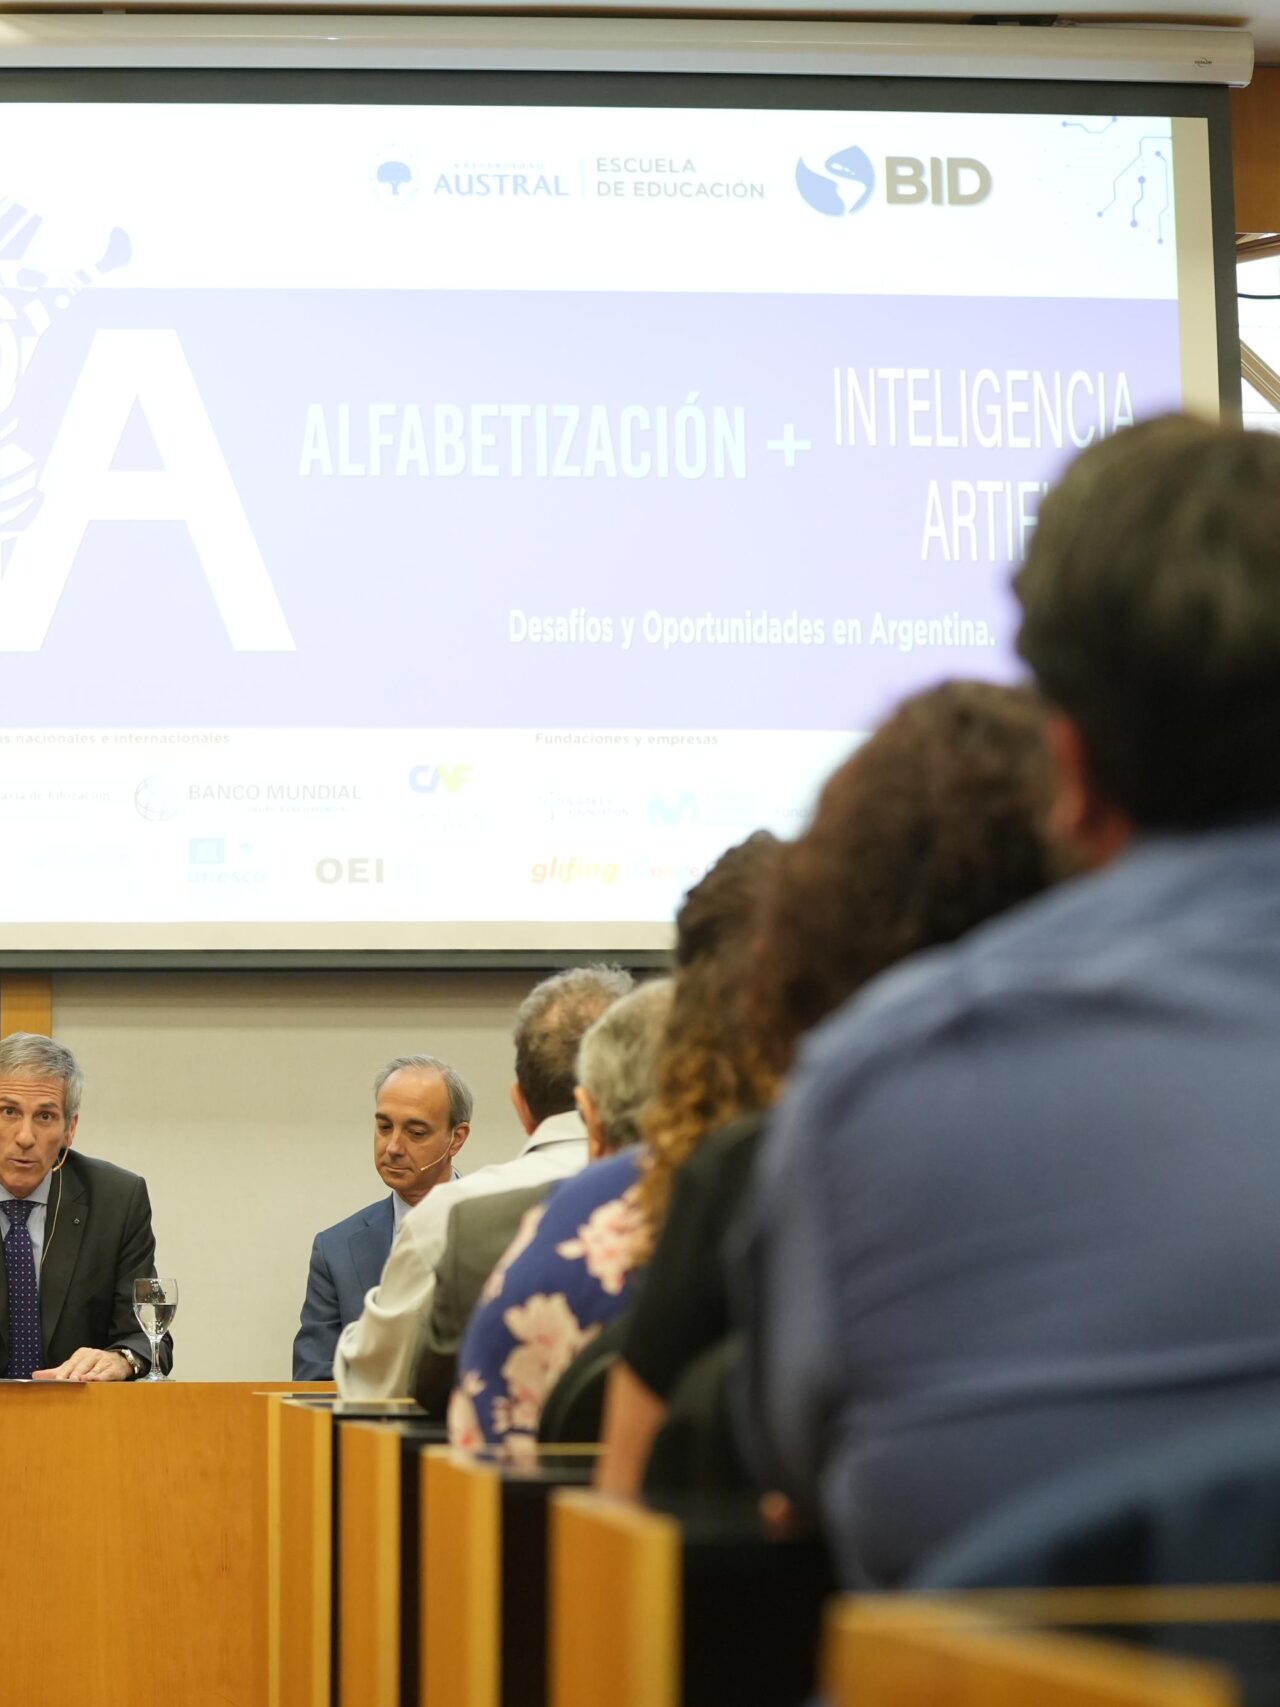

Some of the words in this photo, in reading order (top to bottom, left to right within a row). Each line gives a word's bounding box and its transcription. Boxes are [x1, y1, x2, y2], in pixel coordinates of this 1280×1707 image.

[596, 157, 696, 174] ESCUELA
[433, 173, 570, 197] AUSTRAL
[596, 180, 625, 197] DE
[633, 179, 765, 199] EDUCACIÓN
[885, 156, 993, 206] BID
[833, 367, 1137, 450] INTELIGENCIA
[298, 391, 748, 480] ALFABETIZACIÓN
[920, 479, 1048, 561] ARTIF
[508, 606, 614, 644] Desafíos
[620, 616, 637, 650] y
[642, 609, 826, 650] Oportunidades
[832, 618, 863, 645] en
[869, 610, 996, 652] Argentina.
[15, 731, 97, 745] nacionales
[100, 735, 110, 745] e
[113, 731, 230, 745] internacionales
[534, 732, 630, 745] Fundaciones
[634, 735, 643, 746] y
[647, 735, 719, 746] empresas
[187, 784, 261, 801] BANCO
[266, 784, 361, 801] MUNDIAL
[315, 857, 385, 885] OEI
